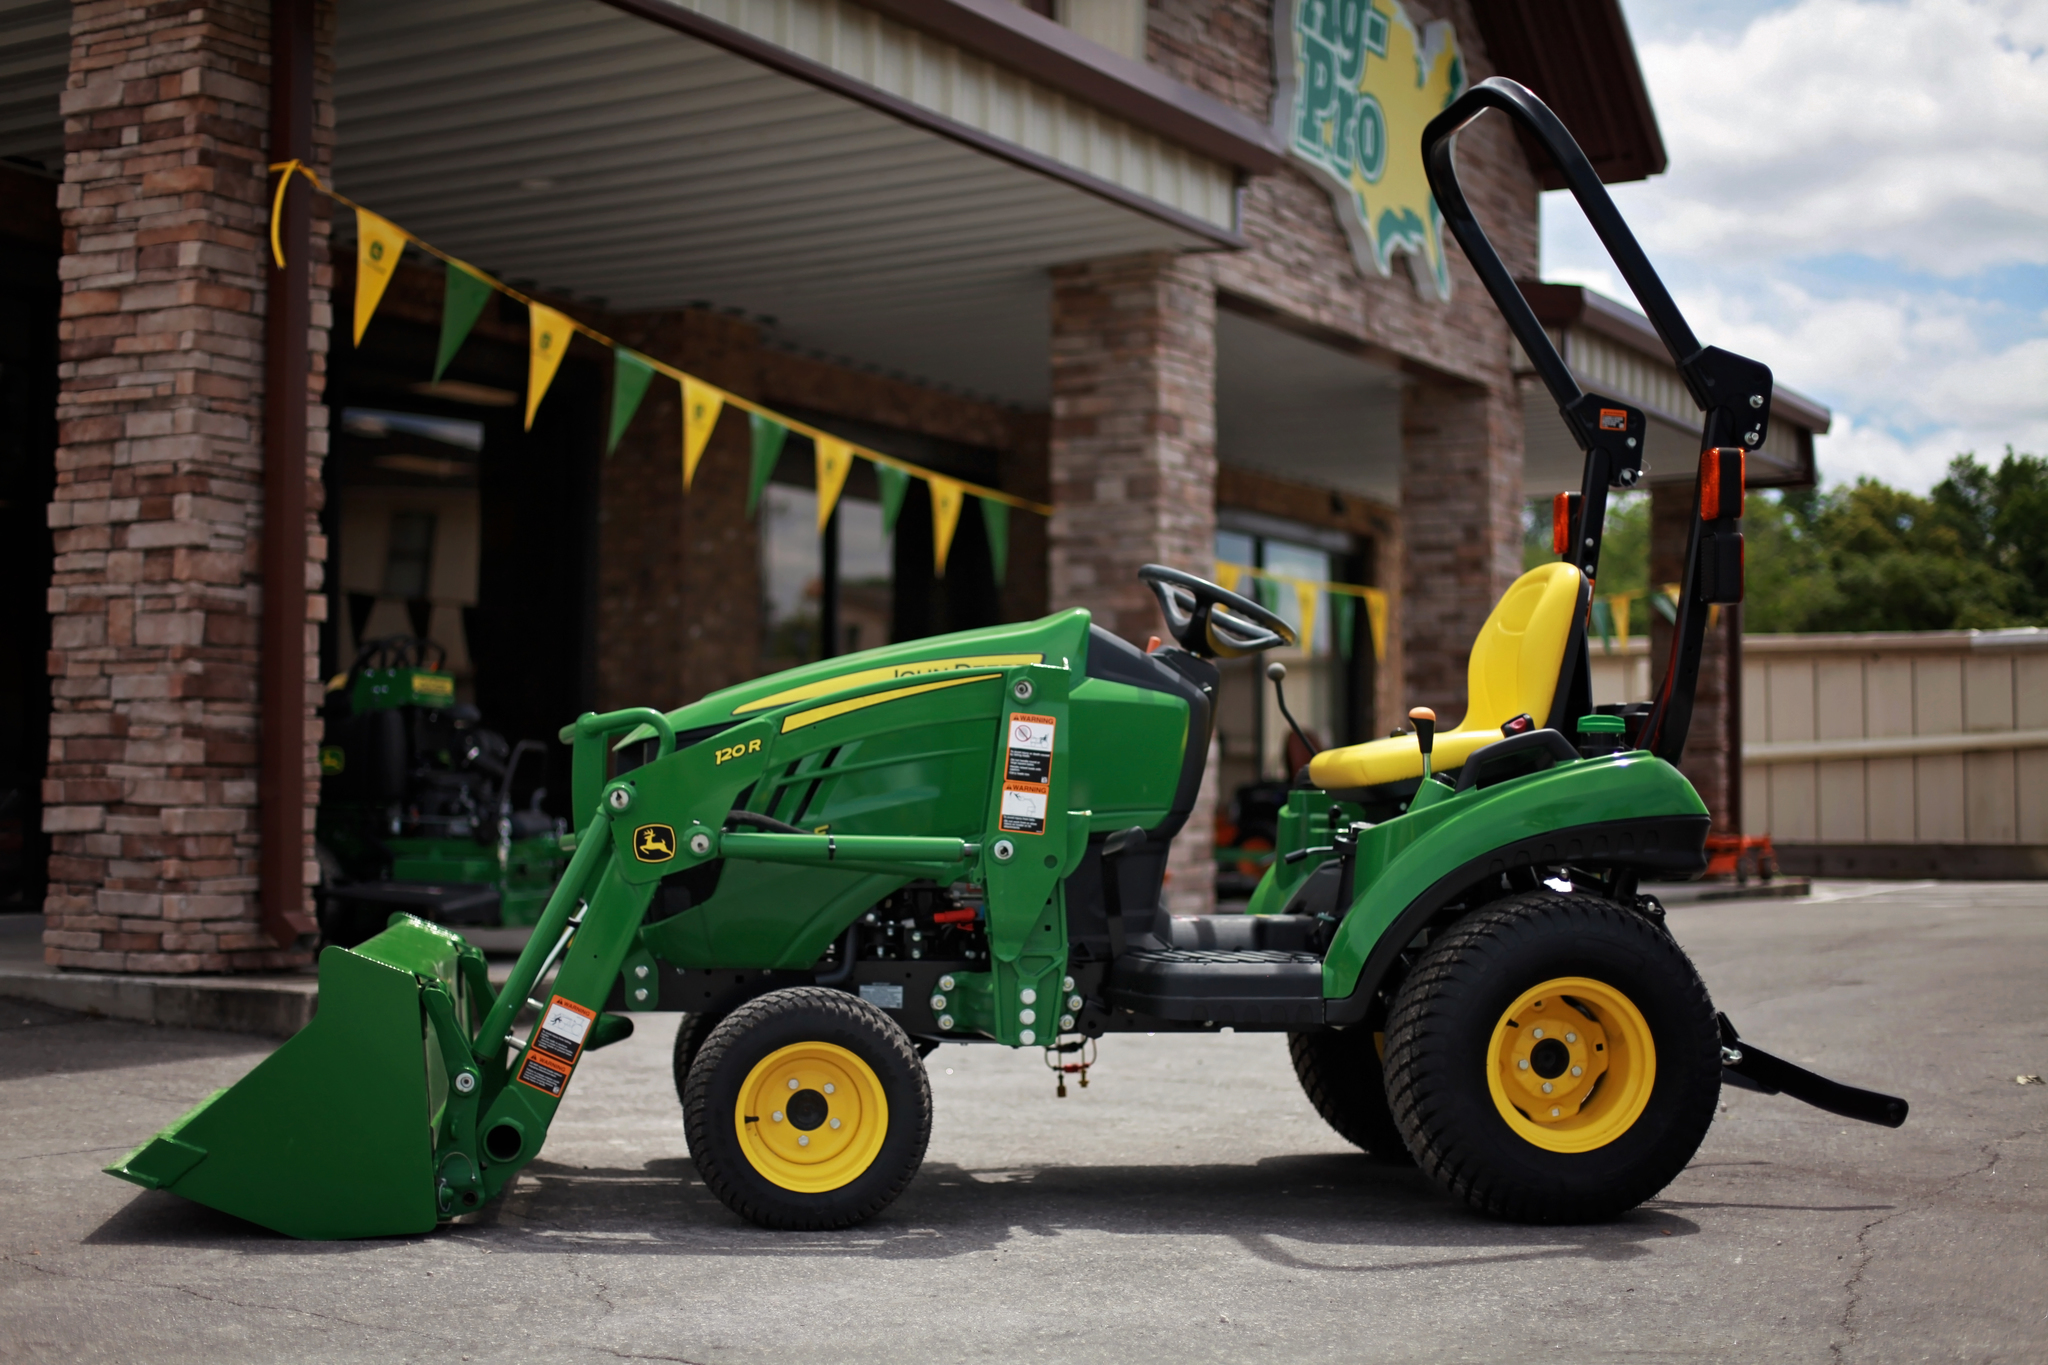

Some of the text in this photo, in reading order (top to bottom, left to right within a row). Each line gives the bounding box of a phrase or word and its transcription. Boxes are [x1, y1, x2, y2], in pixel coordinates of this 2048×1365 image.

[1298, 36, 1386, 180] Pro
[1020, 715, 1054, 725] WARNING
[715, 738, 762, 765] 120 R
[1012, 784, 1047, 794] WARNING
[563, 1001, 591, 1017] WARNING
[539, 1056, 566, 1073] WARNING
